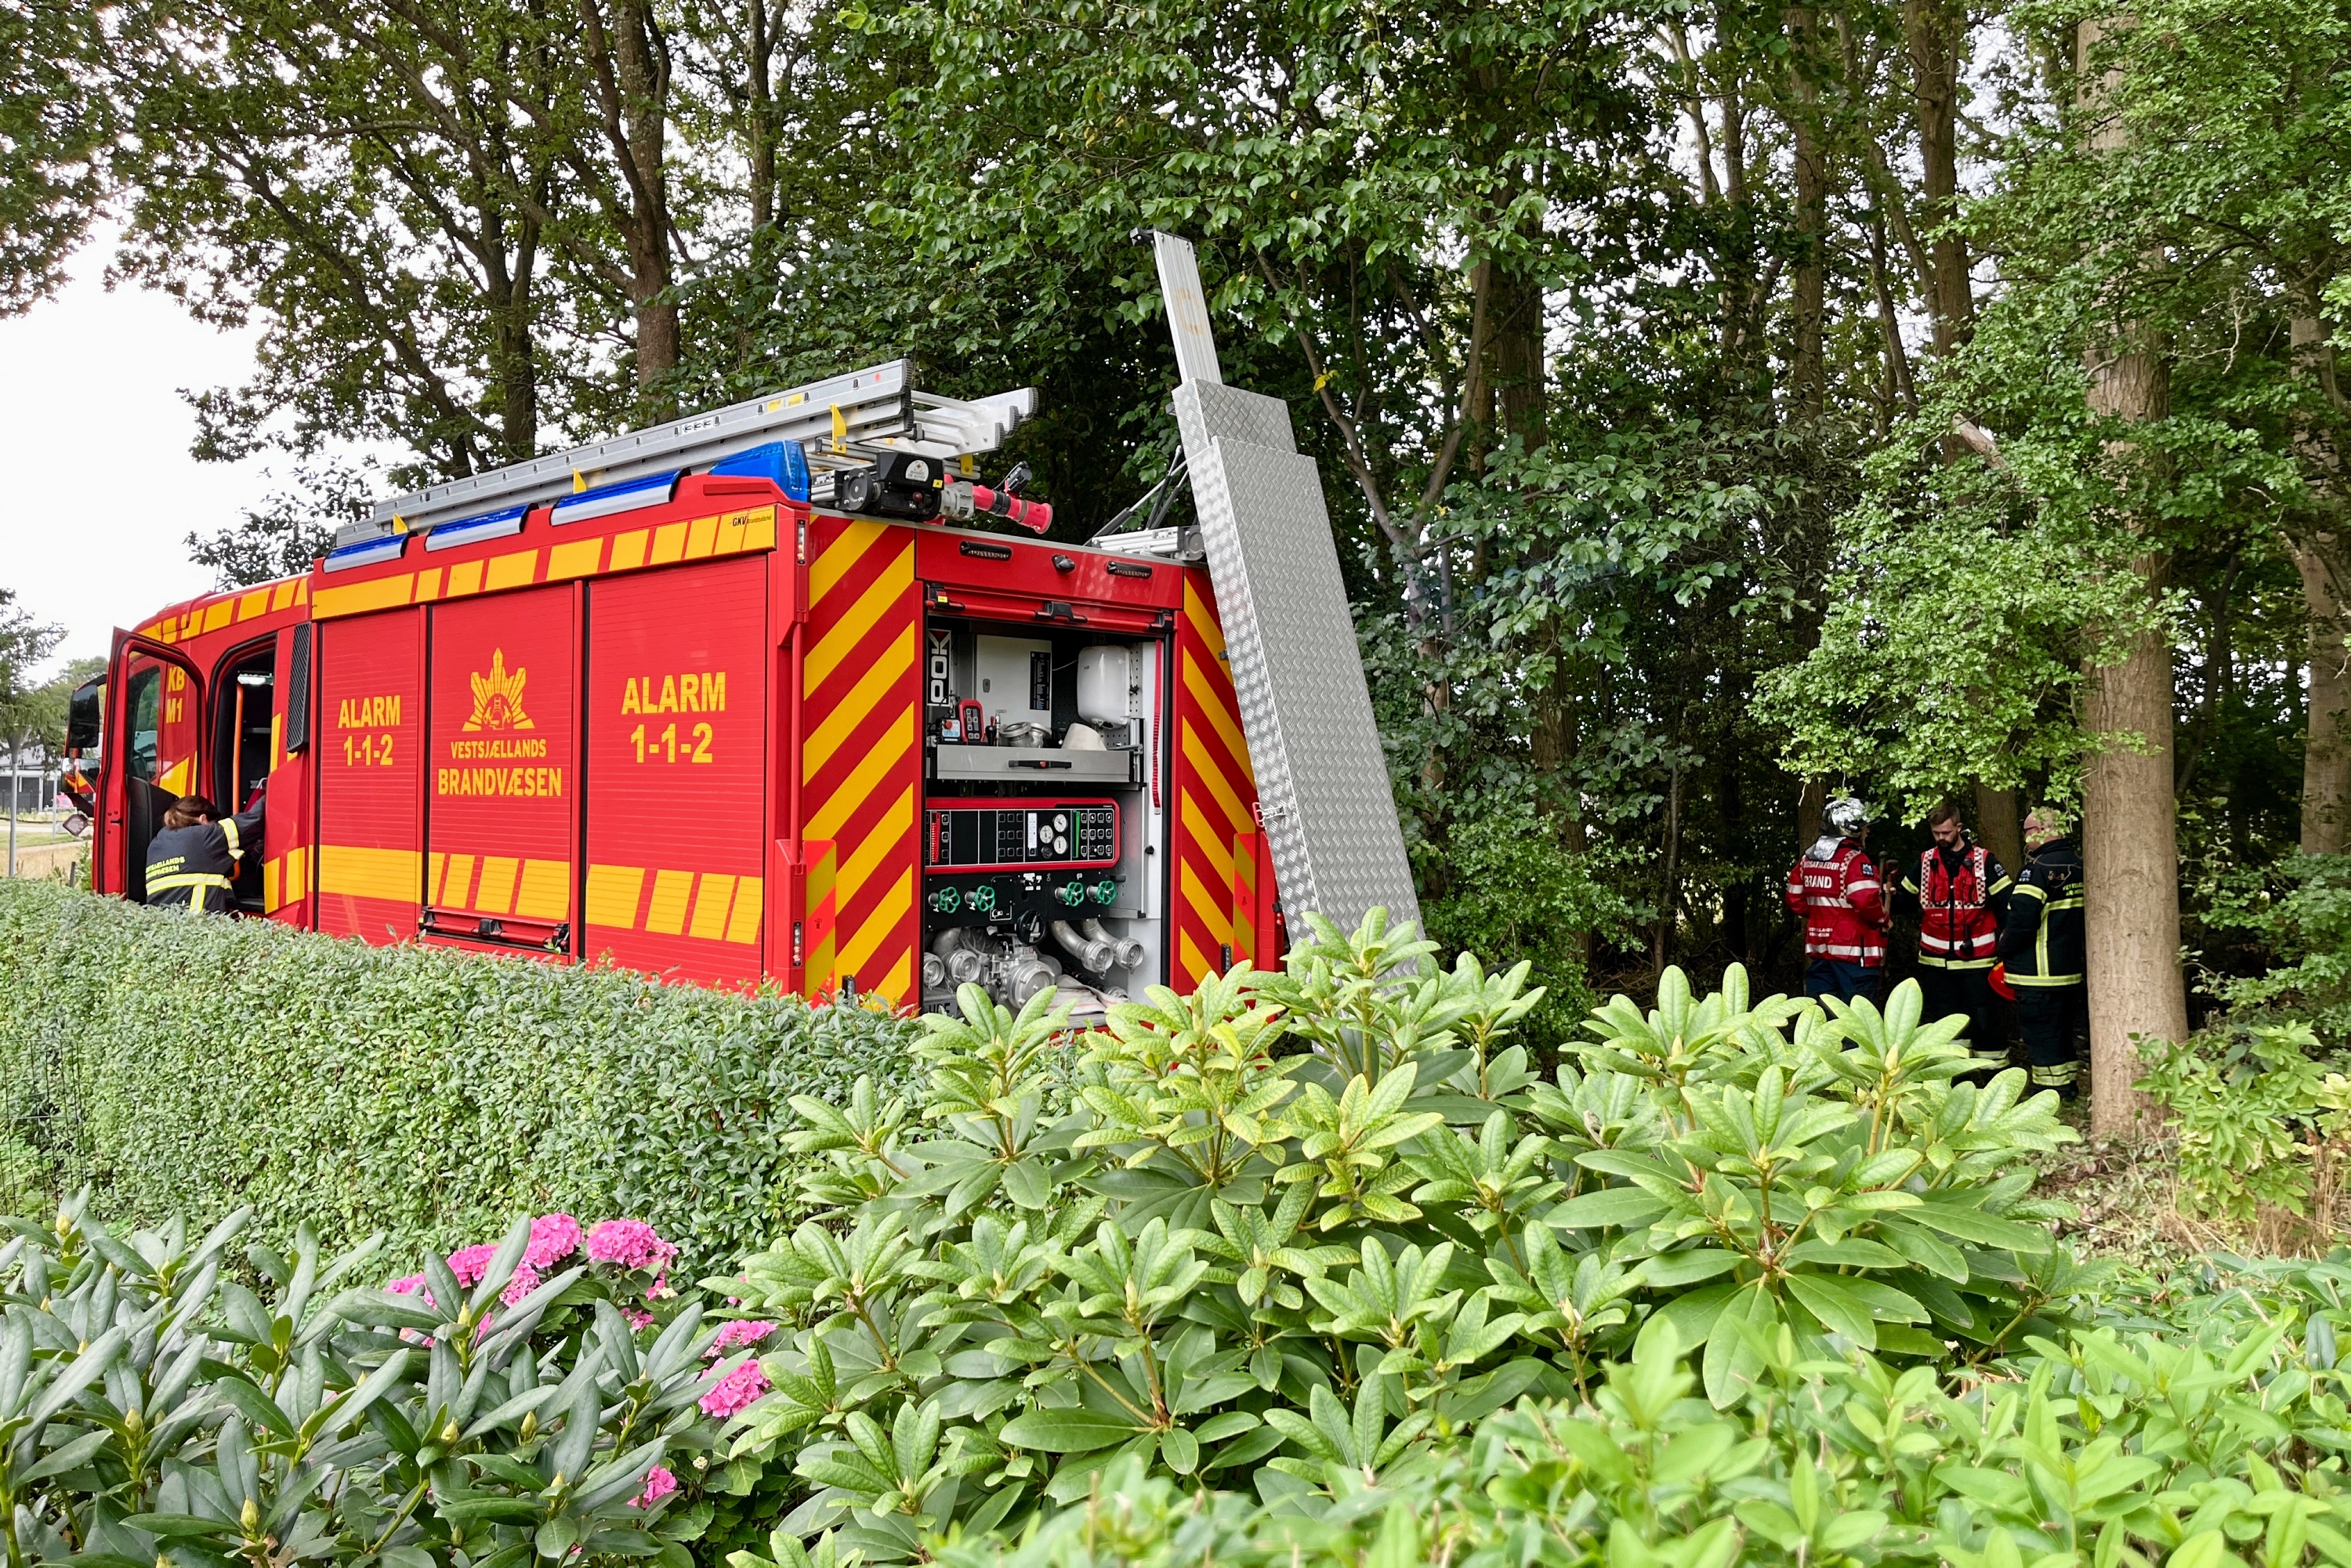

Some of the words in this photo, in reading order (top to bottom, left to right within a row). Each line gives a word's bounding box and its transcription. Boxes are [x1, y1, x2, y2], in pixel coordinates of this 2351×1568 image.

[732, 516, 747, 527] GKV
[168, 667, 186, 693] KB
[620, 672, 726, 715] ALARM
[166, 697, 183, 723] M1
[337, 695, 400, 729] ALARM
[343, 733, 393, 766] 1-1-2
[451, 739, 547, 759] VESTSJÆLLANDS
[630, 722, 713, 763] 1-1-2
[438, 767, 562, 797] BRANDVÆSEN
[1804, 875, 1832, 889] BRAND
